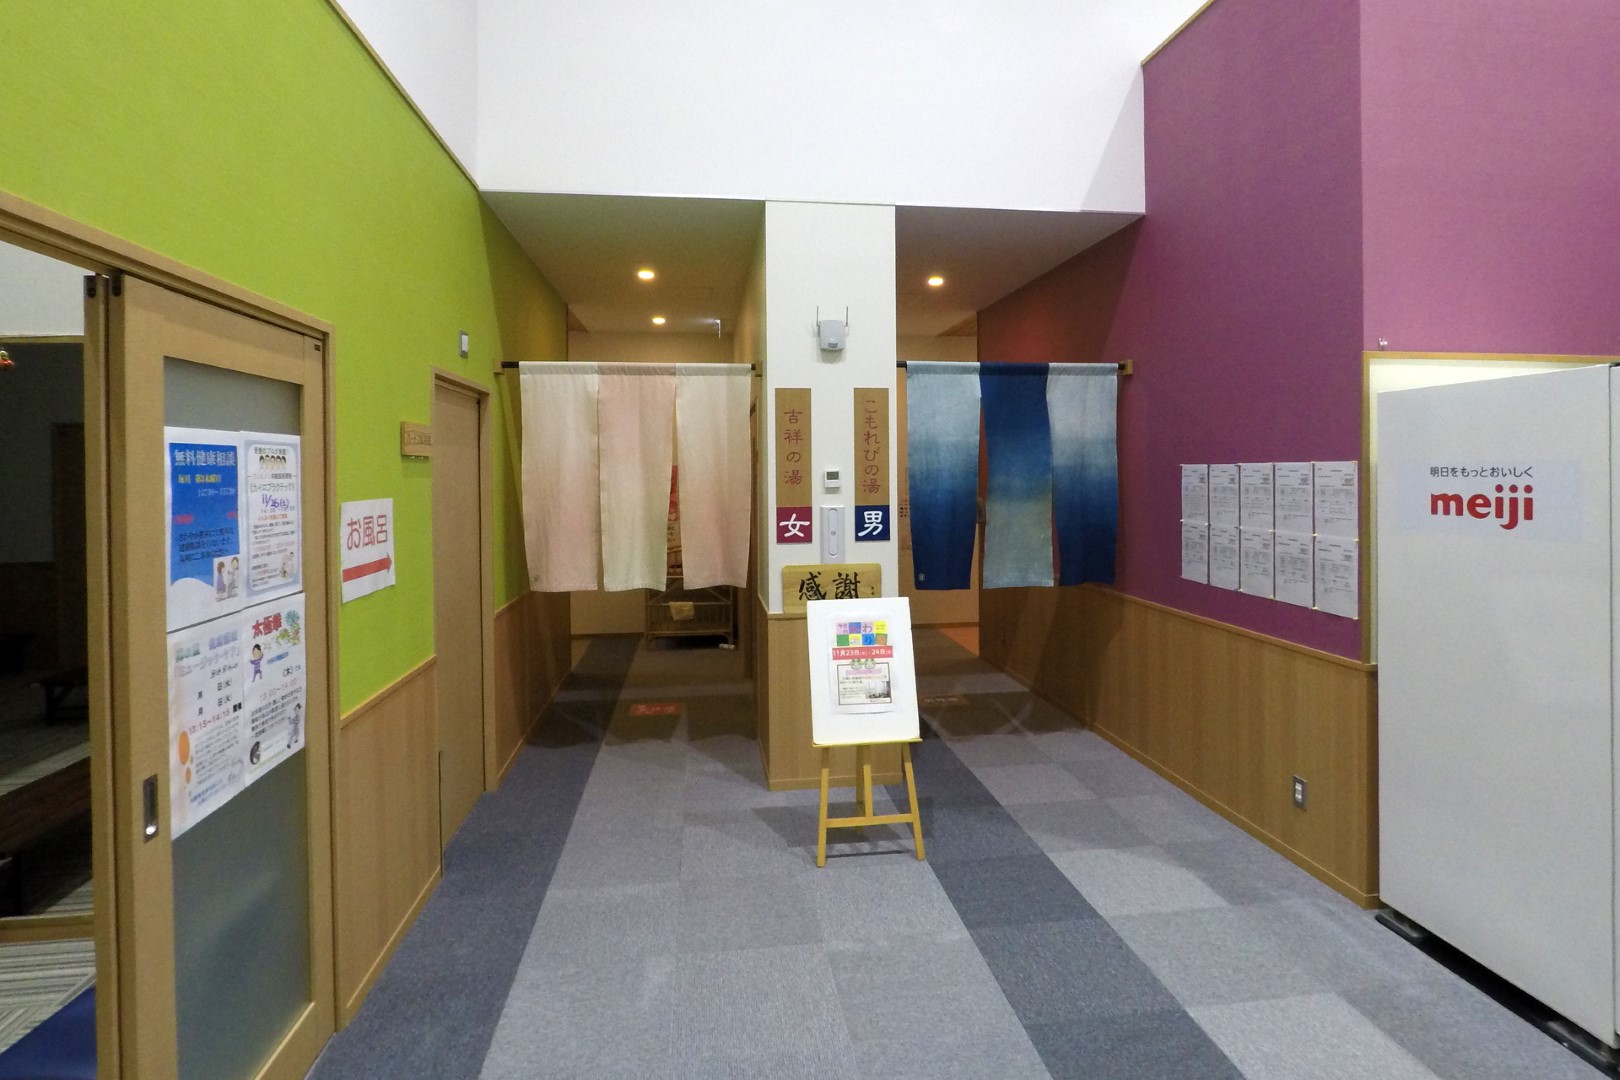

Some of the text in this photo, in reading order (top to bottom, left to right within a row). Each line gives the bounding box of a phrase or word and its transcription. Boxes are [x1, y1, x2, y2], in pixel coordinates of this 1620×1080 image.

[174, 449, 236, 466] 無料健康相談
[783, 408, 804, 486] 吉祥の湯
[862, 399, 881, 494] こもれびの湯
[1429, 466, 1534, 478] 明日をもっとおいしく
[1430, 484, 1534, 530] meiji
[346, 514, 388, 551] お風呂
[779, 513, 811, 538] 女
[857, 510, 883, 537] 男
[798, 571, 861, 601] 感謝
